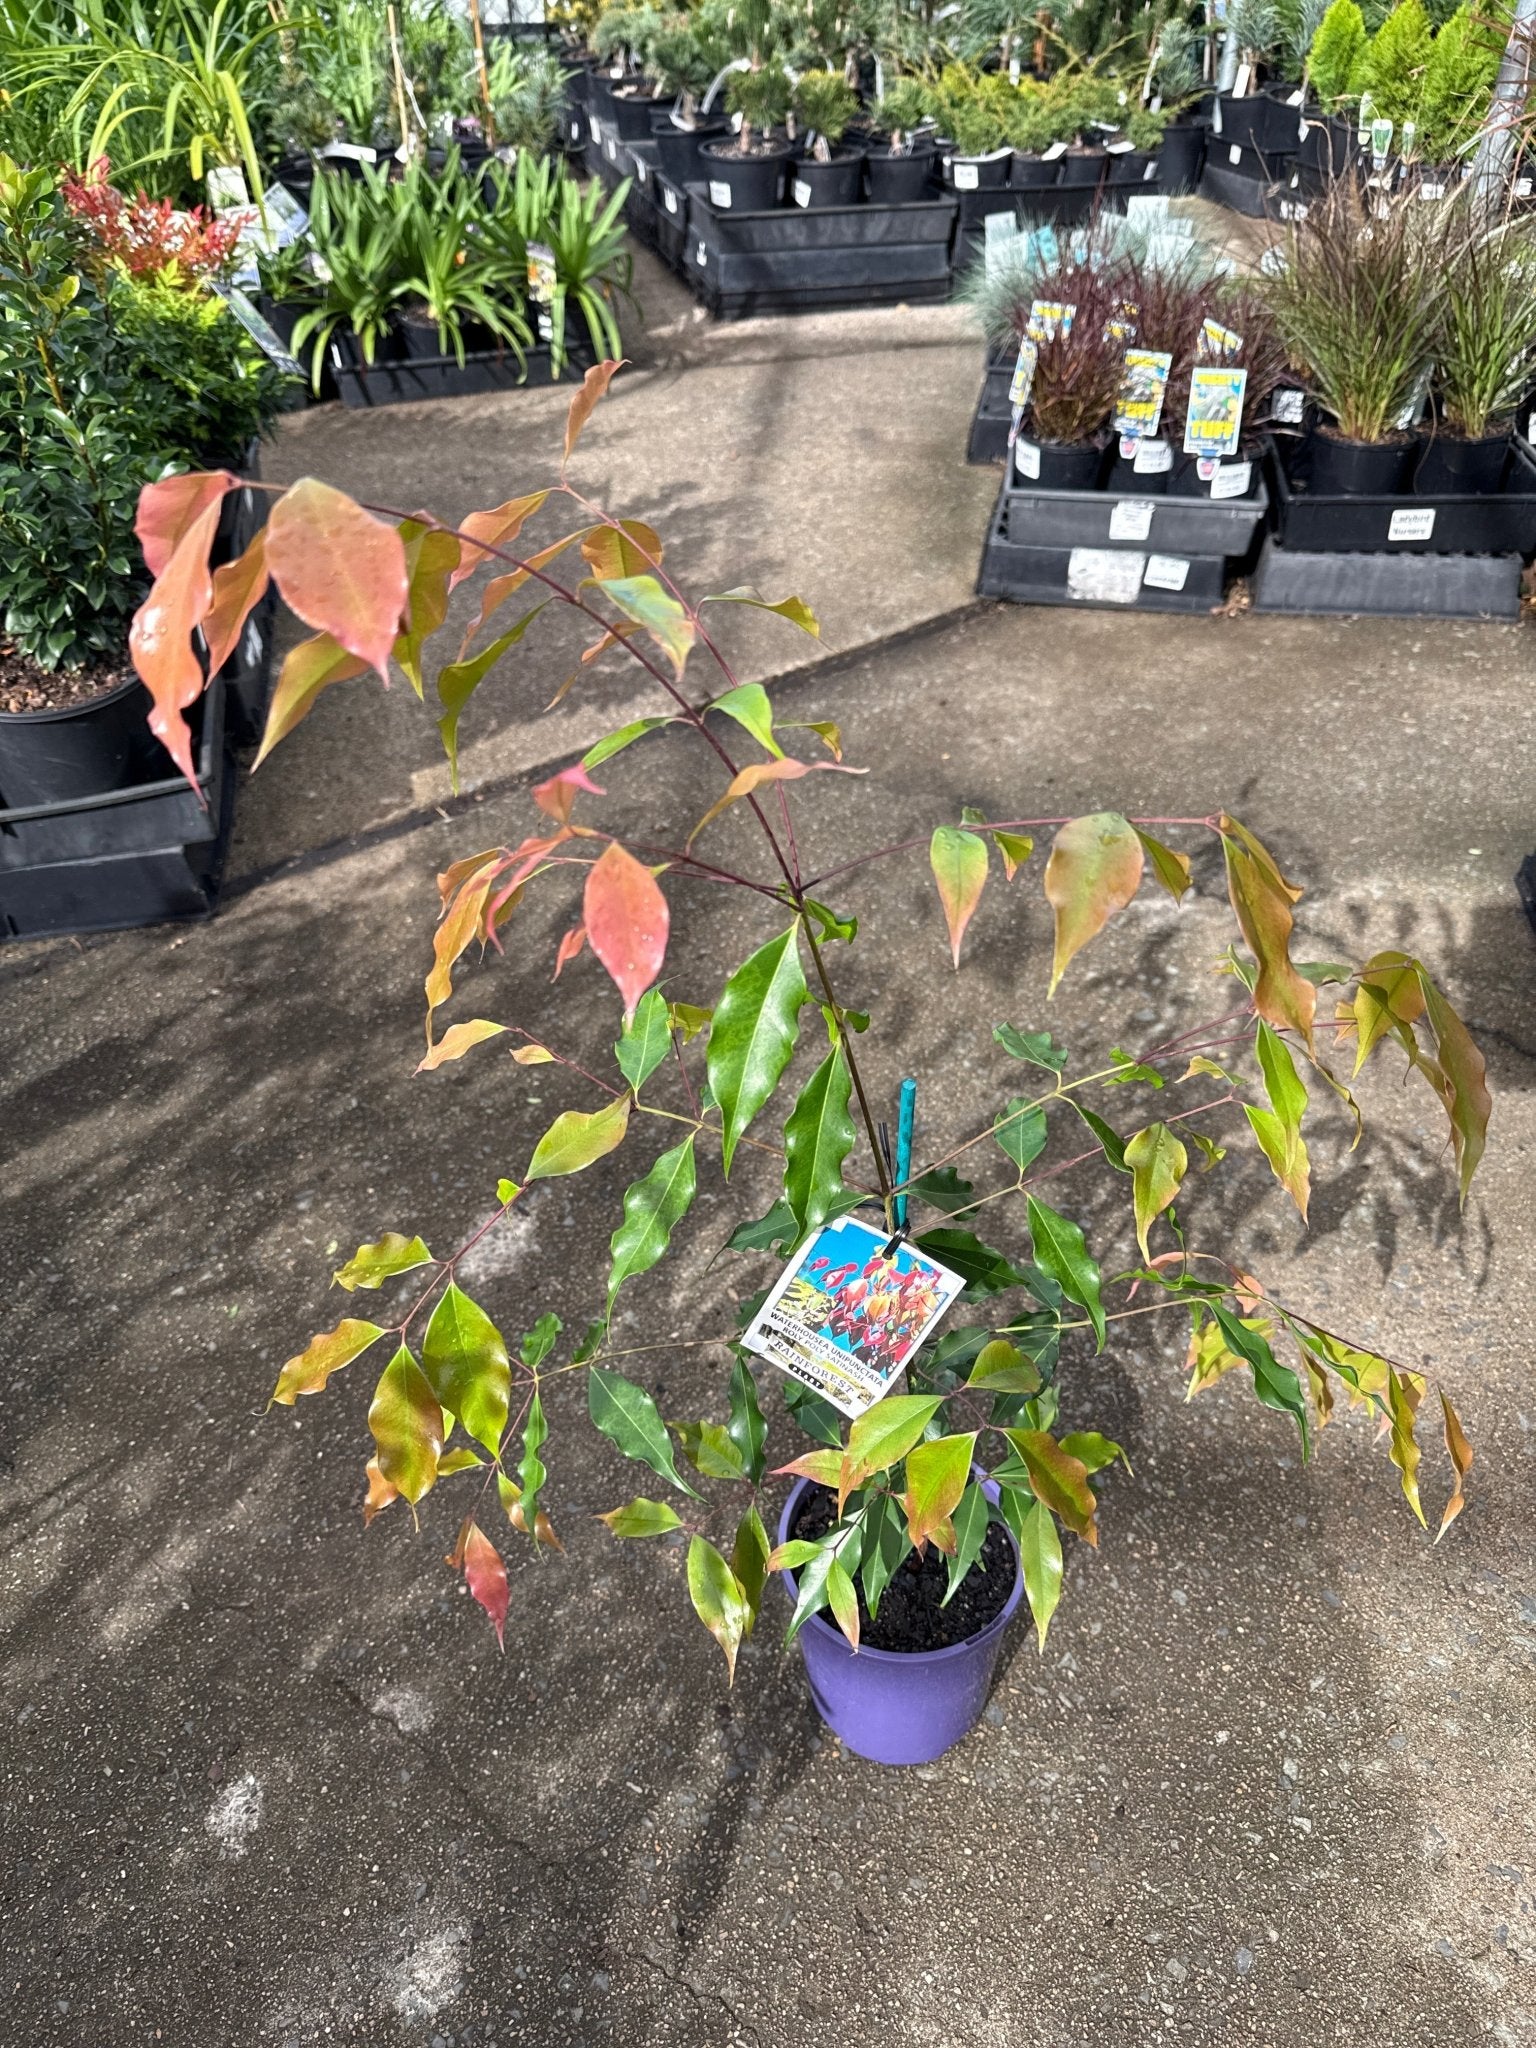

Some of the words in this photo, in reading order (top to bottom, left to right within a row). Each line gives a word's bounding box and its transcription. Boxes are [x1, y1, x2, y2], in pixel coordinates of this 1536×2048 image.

[770, 1311, 830, 1350] WATERHOUSEA
[831, 1346, 884, 1388] UNIPUNCTATA
[773, 1339, 855, 1394] RAINFOREST
[782, 1326, 804, 1342] ROLY
[804, 1339, 827, 1355] POLY
[826, 1353, 865, 1382] SATINASH
